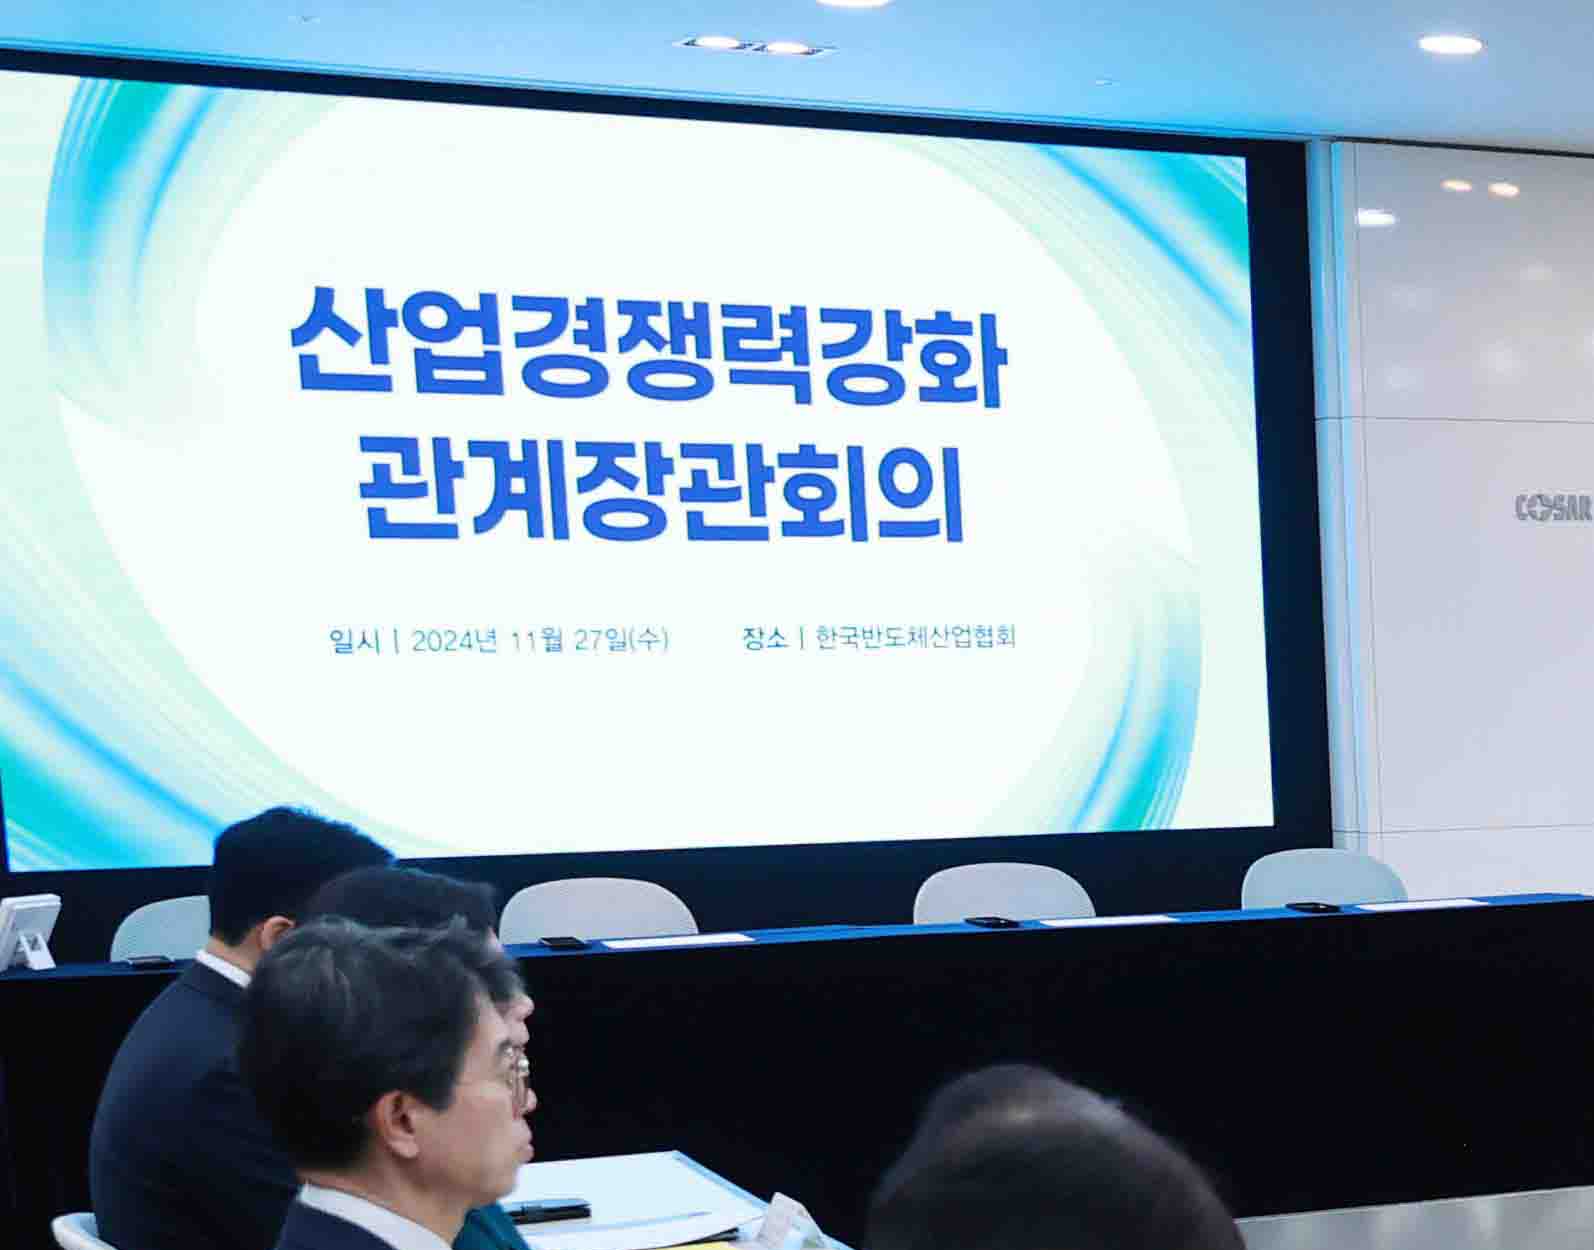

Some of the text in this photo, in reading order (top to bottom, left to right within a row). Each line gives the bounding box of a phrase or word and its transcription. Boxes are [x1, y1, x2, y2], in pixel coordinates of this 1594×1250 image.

[289, 285, 1010, 409] 산업경쟁력강화
[358, 435, 965, 544] 관계장관회의
[328, 627, 381, 656] 일시
[411, 627, 498, 655] 2024년
[510, 627, 564, 653] 11월
[574, 626, 670, 653] 27일(수)
[742, 625, 790, 651] 장소
[814, 624, 1017, 651] 한국반도체산업협회
